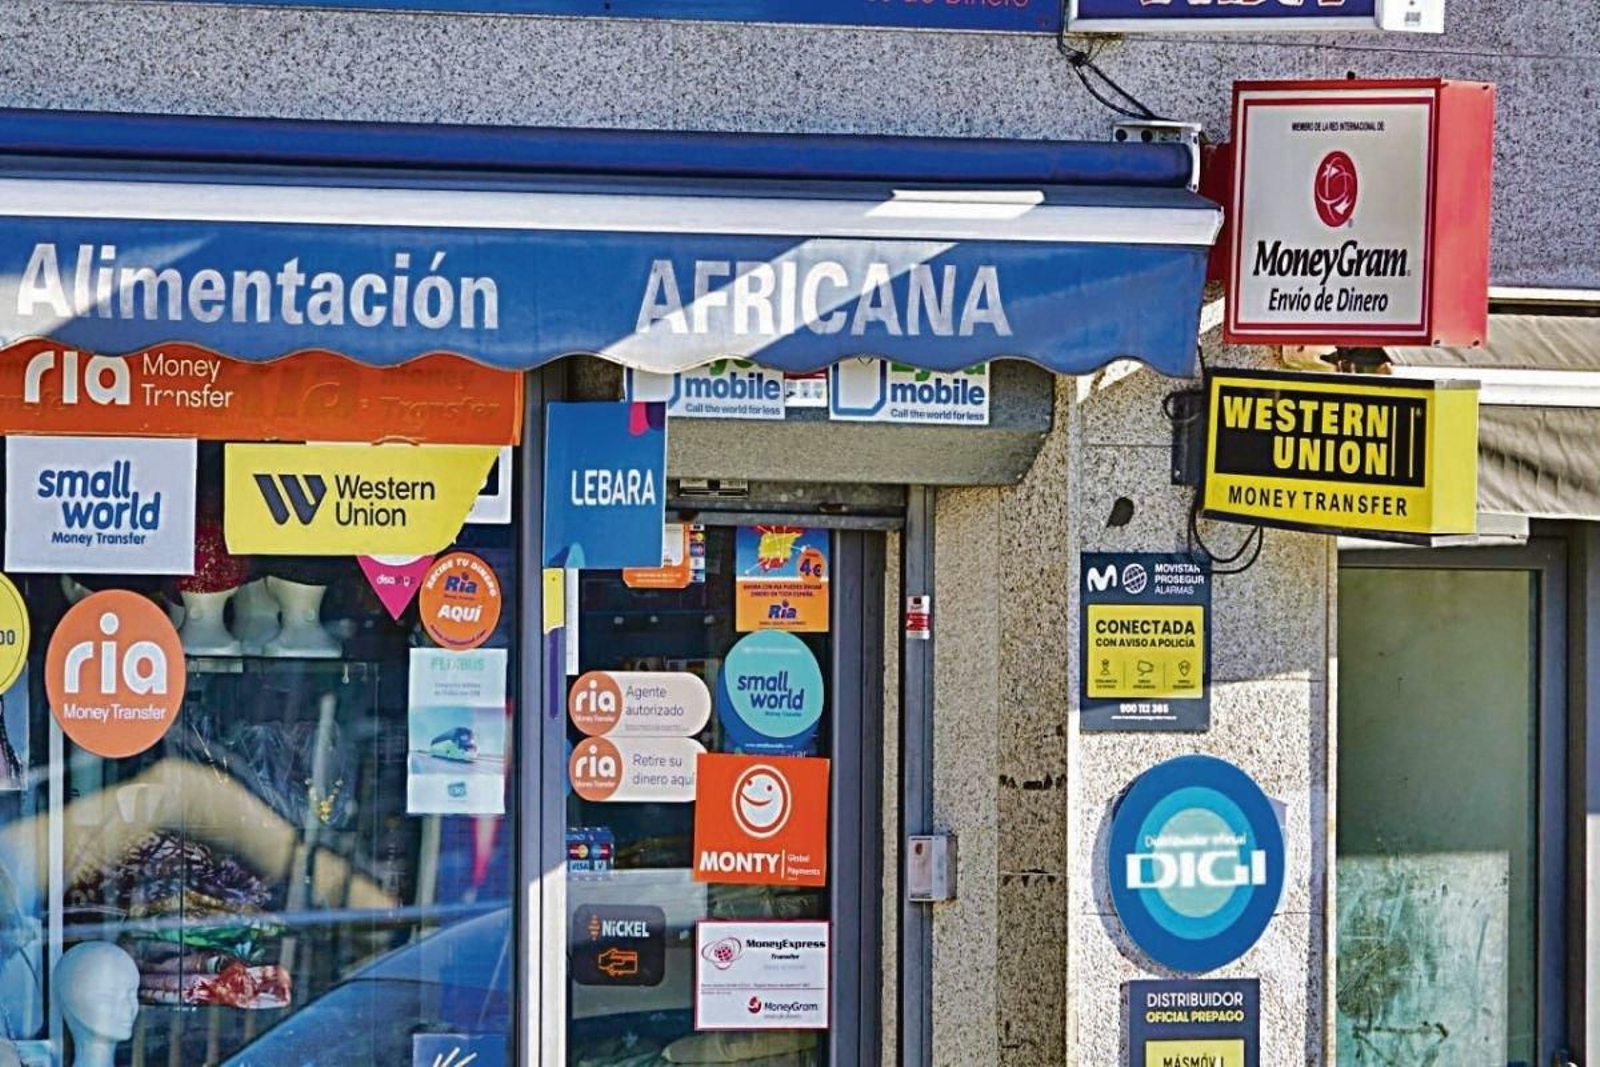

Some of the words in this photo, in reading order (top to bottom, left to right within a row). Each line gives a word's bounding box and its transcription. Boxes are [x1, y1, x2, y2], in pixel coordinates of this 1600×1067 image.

[1253, 239, 1408, 286] MoneyGram
[17, 243, 499, 330] Alimentación
[635, 258, 1013, 337] AFRICANA
[1268, 285, 1312, 312] Envío
[1314, 285, 1334, 312] de
[1336, 287, 1389, 312] Dinero
[143, 352, 221, 383] Money
[685, 371, 781, 400] mobile
[890, 378, 985, 406] mobile
[685, 403, 703, 414] Call
[704, 403, 721, 414] the
[722, 404, 747, 415] world
[749, 404, 762, 415] for
[763, 405, 781, 416] less
[890, 408, 909, 419] Call
[910, 409, 925, 419] the
[926, 409, 951, 421] world
[952, 410, 965, 421] for
[966, 411, 985, 421] less
[1222, 396, 1389, 439] WESTERN
[1272, 436, 1388, 477] UNION
[37, 460, 131, 499] small
[334, 474, 436, 501] Western
[571, 468, 657, 506] LEBARA
[62, 491, 161, 531] world
[1228, 485, 1298, 510] MONEY
[1304, 491, 1408, 517] TRANSFER
[335, 502, 407, 527] Union
[51, 532, 94, 548] Money
[96, 532, 147, 545] Transfer
[444, 571, 478, 594] Ria
[456, 558, 470, 567] TU
[470, 562, 498, 598] DINERO
[1154, 574, 1205, 585] PROSEGUR
[1154, 585, 1195, 596] ALARMAS
[437, 604, 483, 623] AQUÍ
[768, 600, 797, 619] Ria
[1095, 620, 1196, 635] CONECTADA
[64, 612, 168, 695] ria
[1095, 638, 1118, 648] CON
[1119, 638, 1149, 648] AVISO
[1150, 638, 1157, 648] A
[1158, 636, 1196, 648] POLICÍA
[626, 685, 668, 700] Agente
[737, 671, 788, 691] small
[575, 679, 616, 712] ria
[750, 688, 805, 710] world
[63, 703, 110, 725] Money
[111, 703, 166, 719] Transfer
[625, 704, 685, 716] autorizado
[575, 744, 616, 778] ria
[632, 753, 667, 767] Retire
[668, 757, 683, 768] su
[632, 774, 668, 786] dinero
[699, 850, 780, 874] MONTY
[1126, 849, 1267, 889] DIGI
[746, 939, 827, 950] MoneyExpress
[764, 1001, 818, 1014] MoneyGram
[1146, 991, 1243, 1008] DISTRIBUIDOR
[1145, 1010, 1190, 1023] OFICIAL
[1191, 1010, 1245, 1023] PREPAGO
